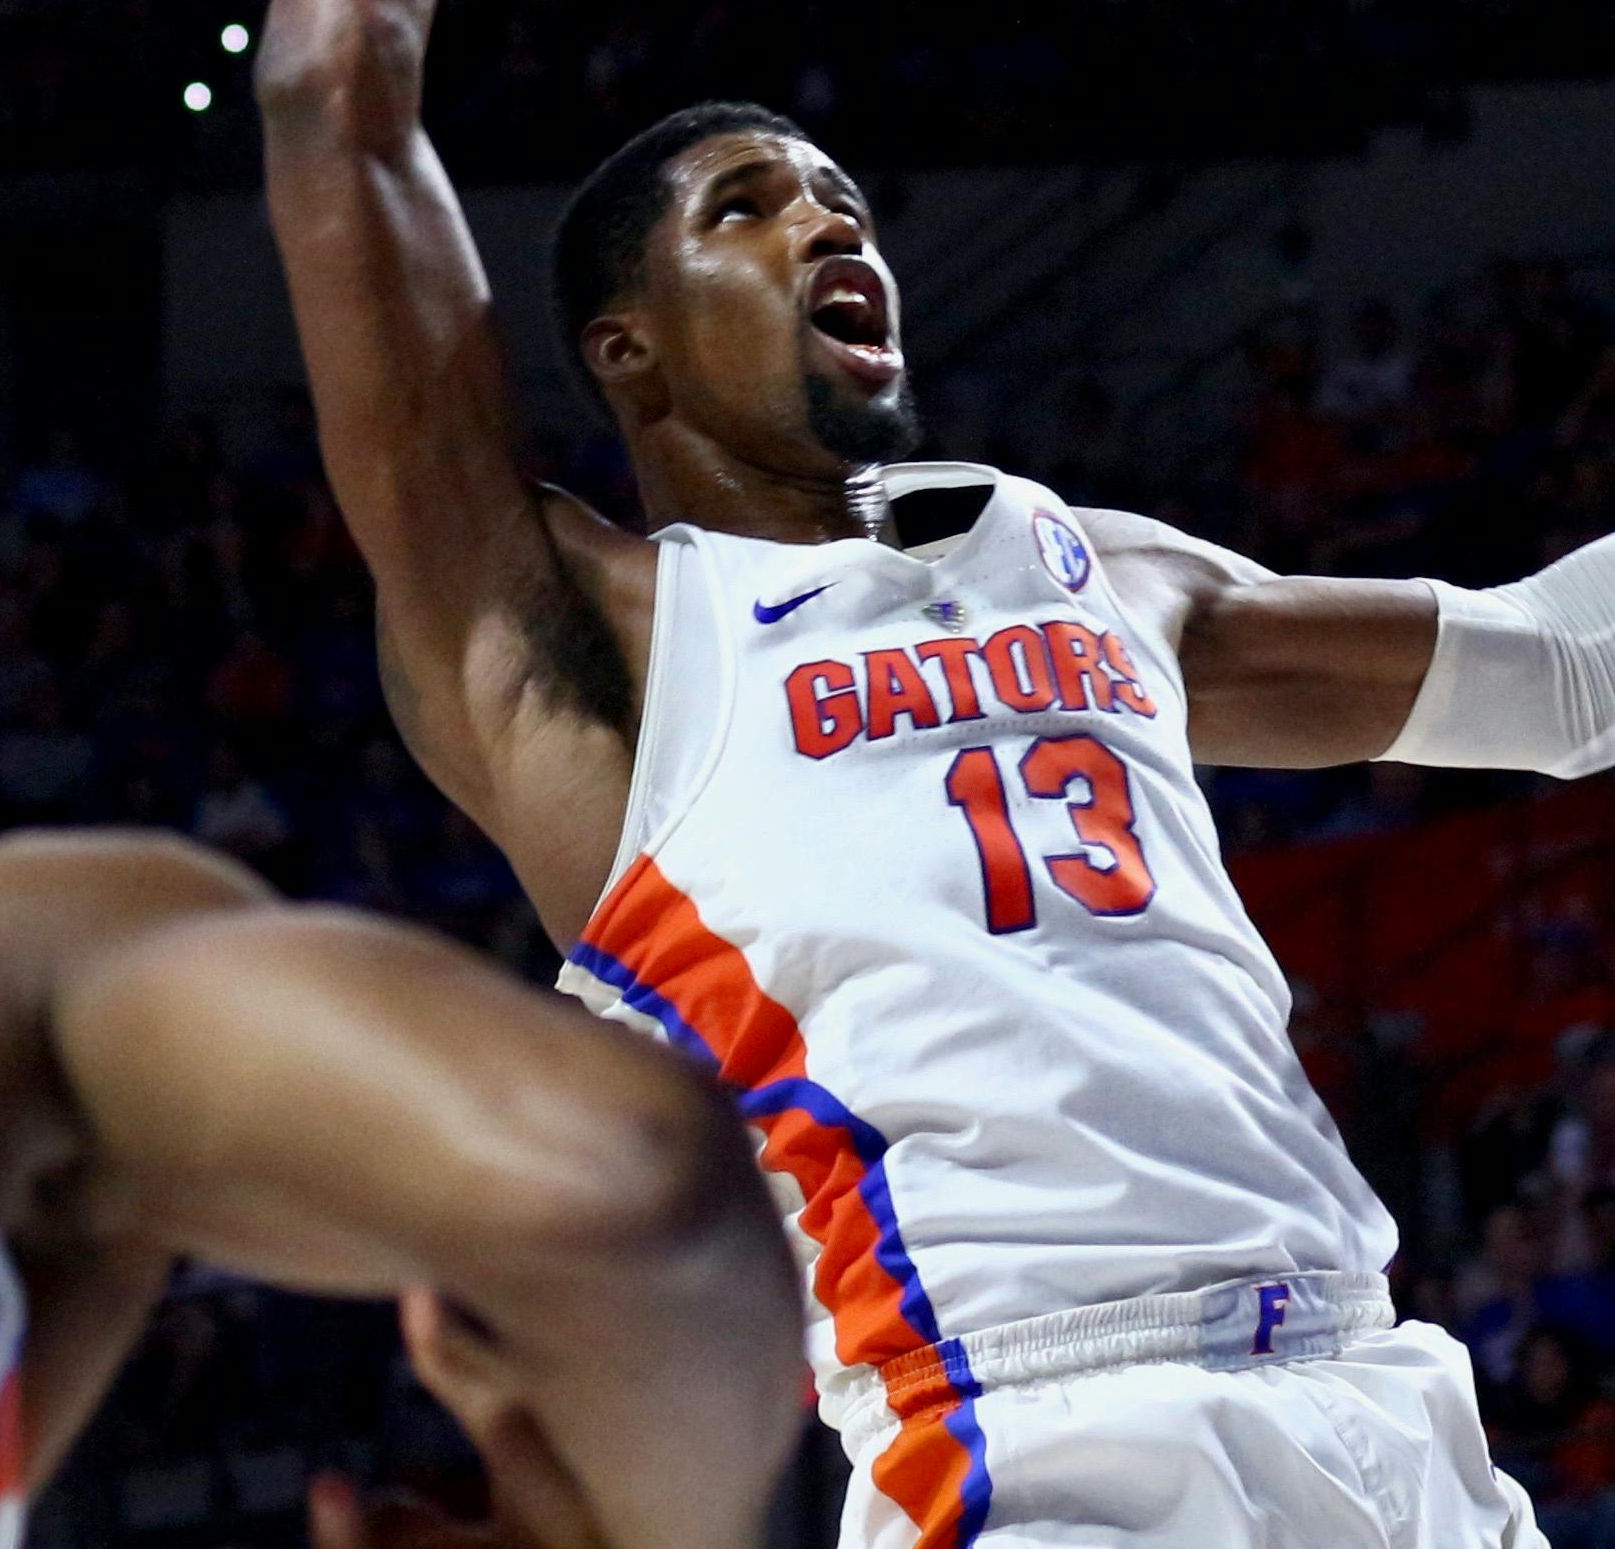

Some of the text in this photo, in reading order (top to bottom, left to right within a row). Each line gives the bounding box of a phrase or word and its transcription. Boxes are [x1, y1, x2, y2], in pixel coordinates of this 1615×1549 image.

[784, 620, 1158, 760] GATORS
[944, 733, 1157, 935] 13
[1250, 1283, 1290, 1355] F
